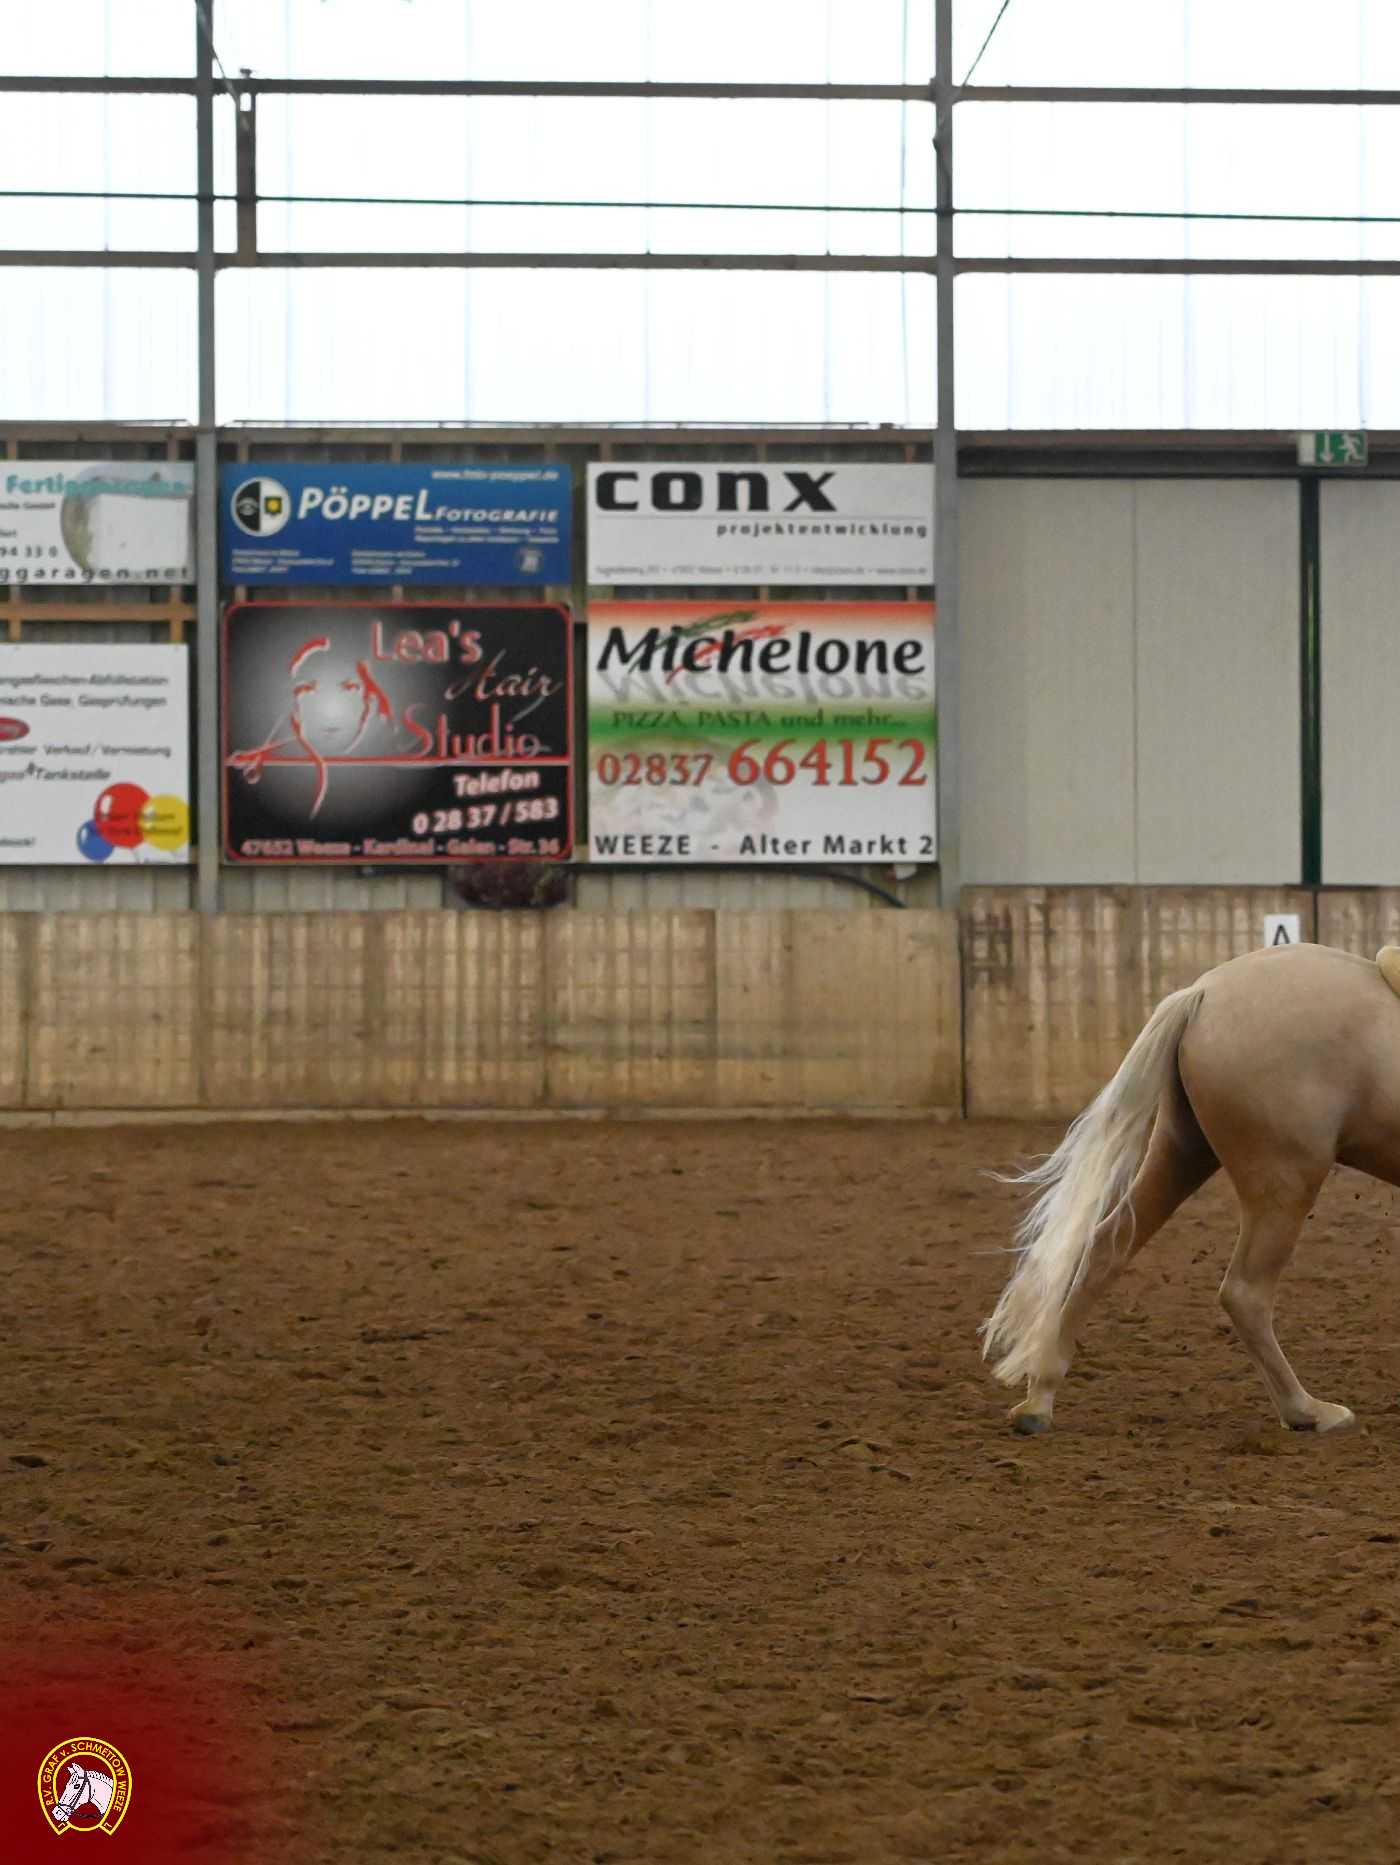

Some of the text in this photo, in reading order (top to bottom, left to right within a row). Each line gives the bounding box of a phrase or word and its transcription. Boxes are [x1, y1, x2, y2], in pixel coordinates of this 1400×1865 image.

[298, 486, 434, 521] PÖPPEL
[596, 471, 837, 512] conx
[435, 506, 559, 522] FOTOGRAFIE
[717, 522, 928, 538] projektentwicklung
[372, 621, 482, 663] Lea's
[597, 625, 926, 675] Michelone
[400, 703, 551, 757] Studio
[698, 711, 771, 728] PASTA
[780, 709, 823, 728] und
[597, 738, 927, 786] 02837 664152
[454, 769, 540, 797] Telefon
[595, 835, 690, 855] WEEZE
[739, 835, 811, 855] Alter
[823, 835, 907, 855] Markt
[919, 835, 933, 855] 2
[1273, 924, 1290, 946] A
